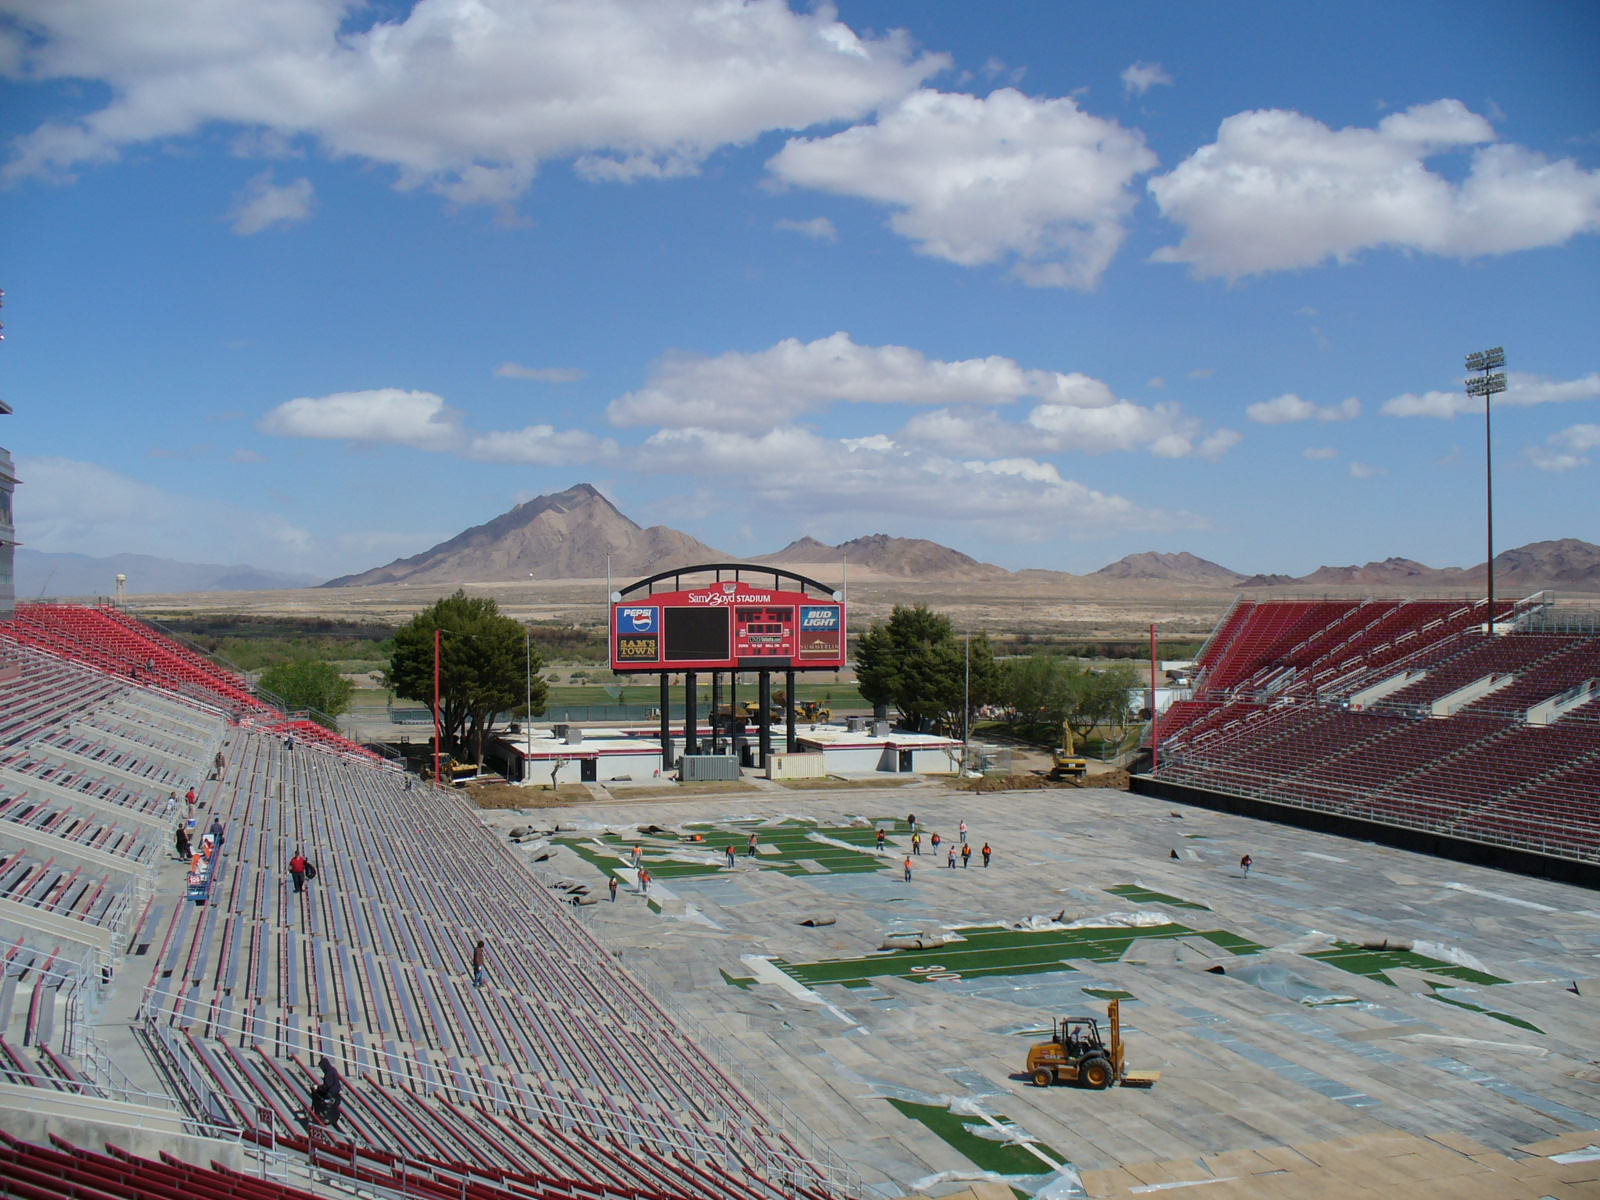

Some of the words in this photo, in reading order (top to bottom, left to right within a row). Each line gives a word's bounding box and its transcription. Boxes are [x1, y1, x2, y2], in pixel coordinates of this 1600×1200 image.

[688, 592, 708, 603] Sam
[736, 594, 771, 602] STADIUM
[623, 609, 652, 617] PEPSI
[803, 618, 836, 626] LIGHT
